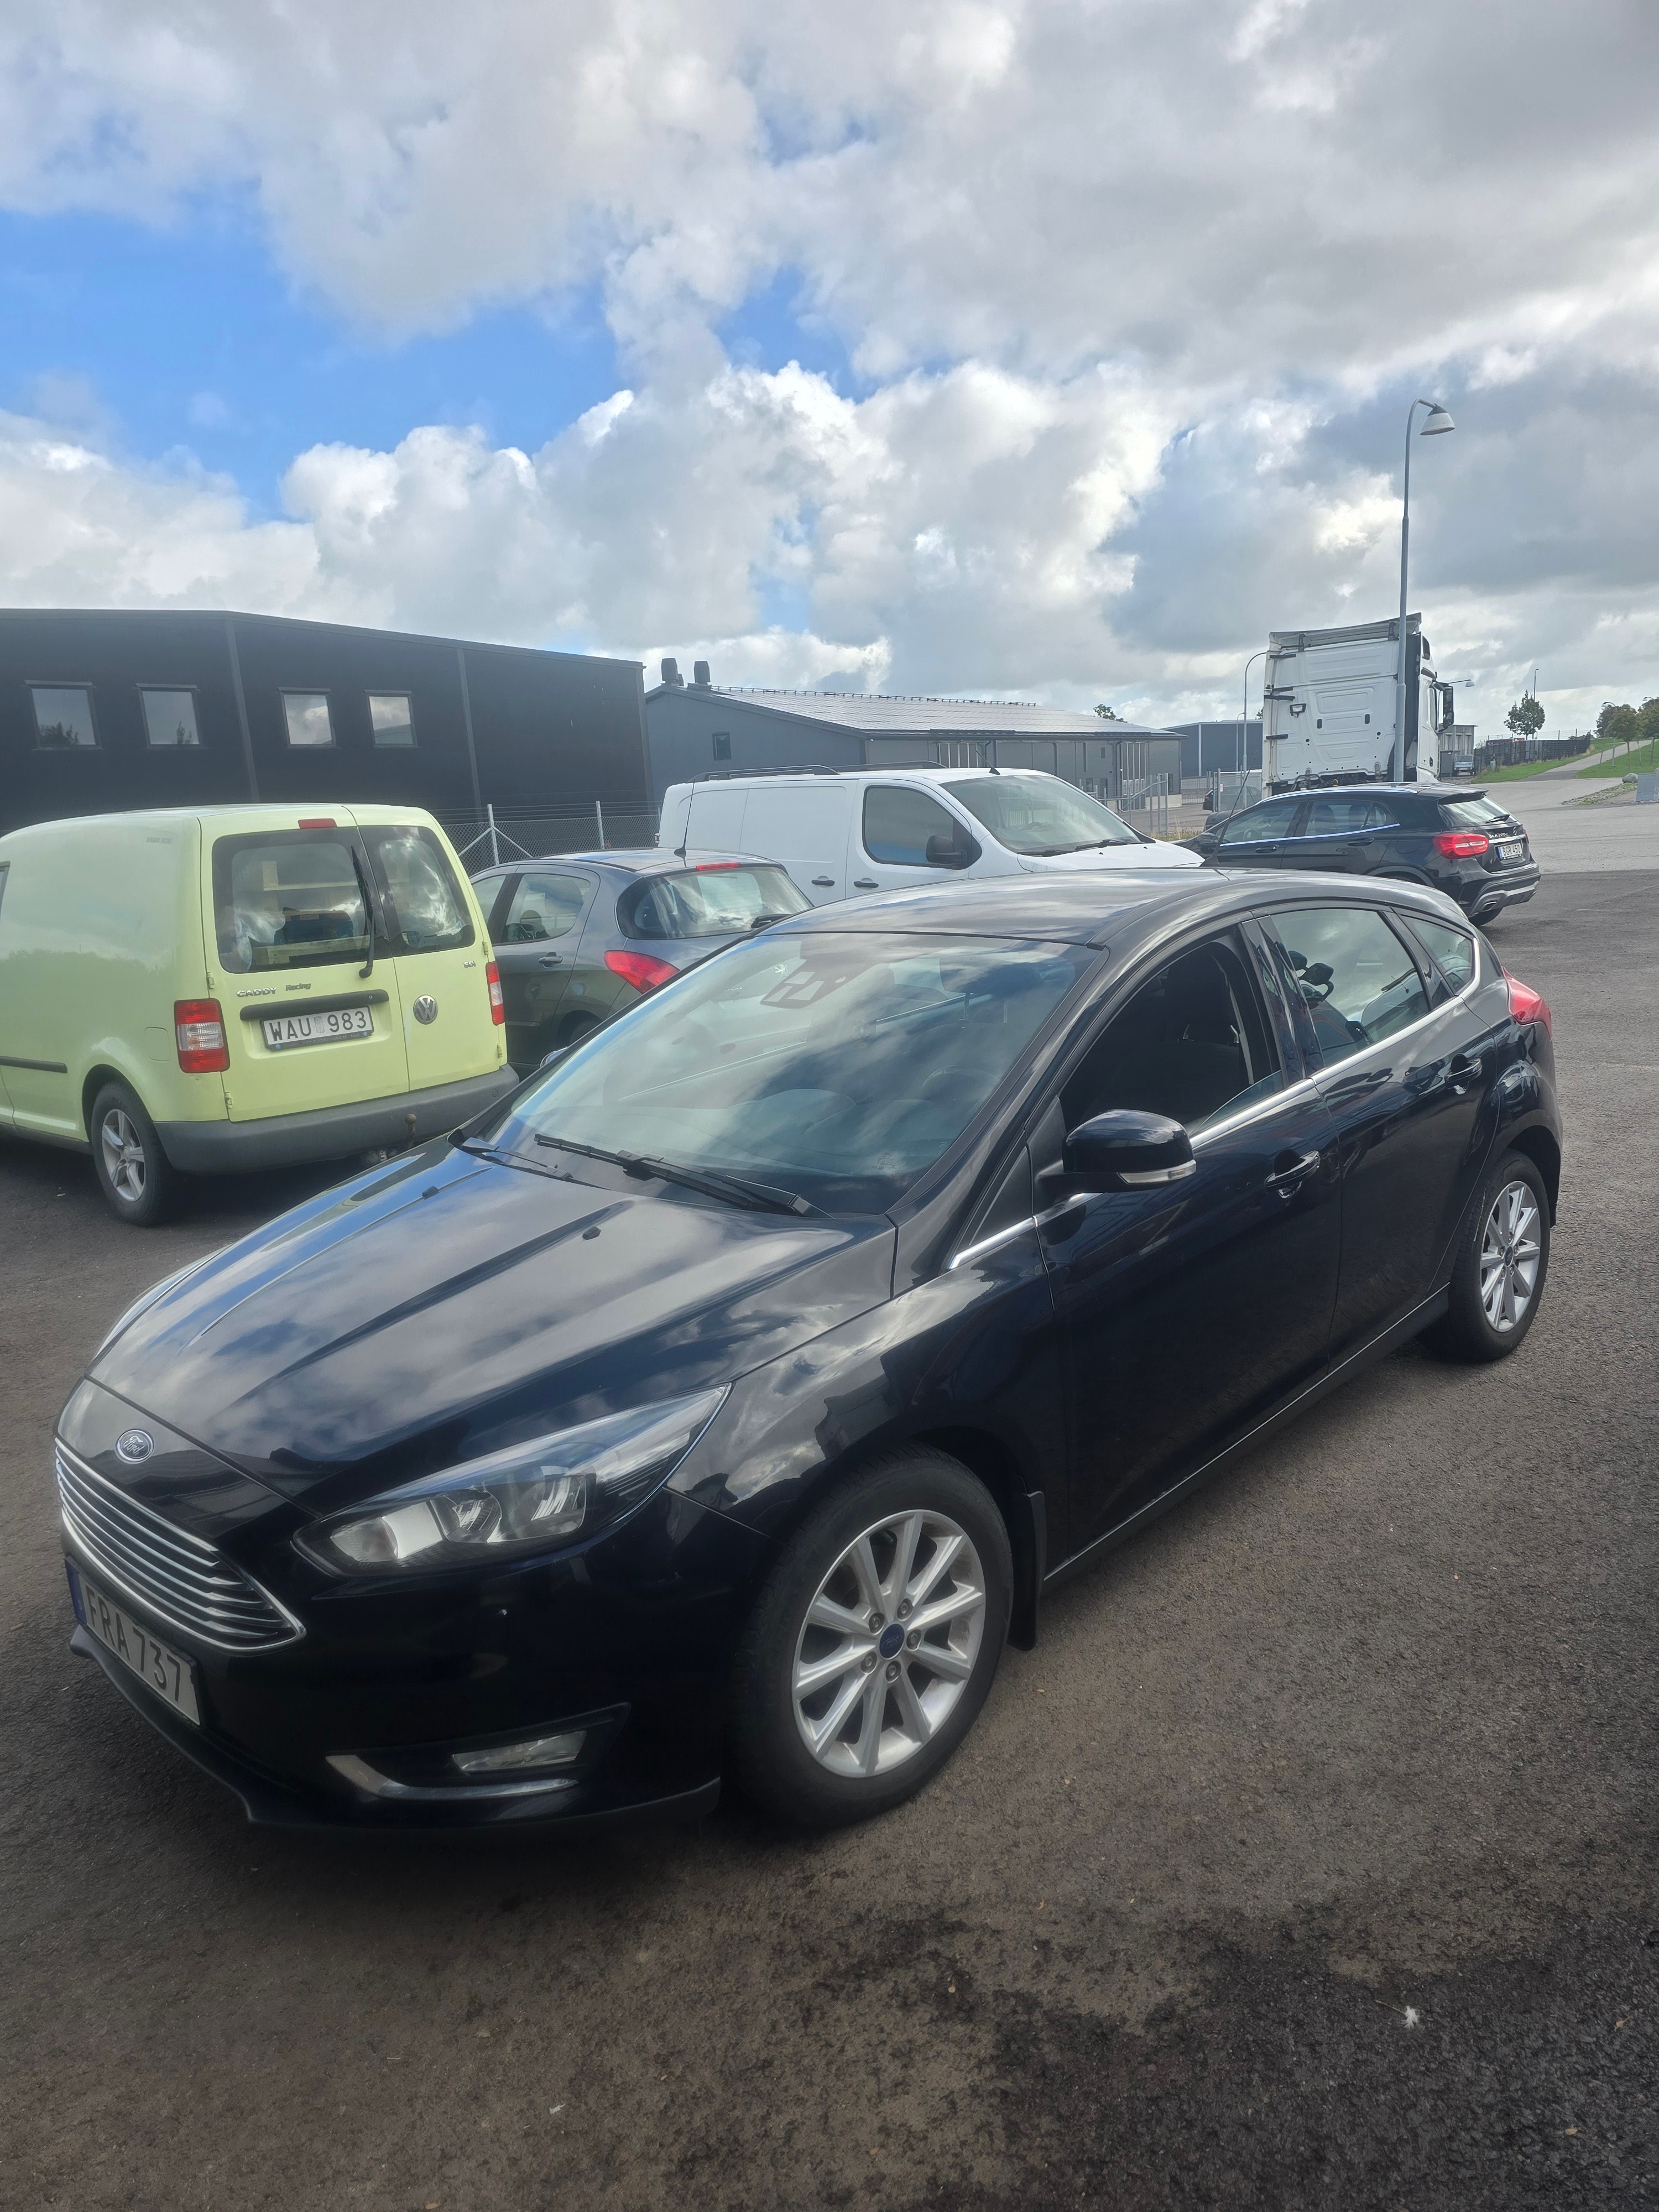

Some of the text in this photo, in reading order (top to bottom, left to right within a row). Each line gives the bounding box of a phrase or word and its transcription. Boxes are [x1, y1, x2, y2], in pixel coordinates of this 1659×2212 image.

[1502, 844, 1521, 856] BGR 450
[236, 983, 311, 998] CADDY Racing
[269, 1017, 311, 1041] WAU
[327, 1010, 367, 1032] 983
[123, 1435, 146, 1455] Ford
[85, 1583, 181, 1703] FRA 737
